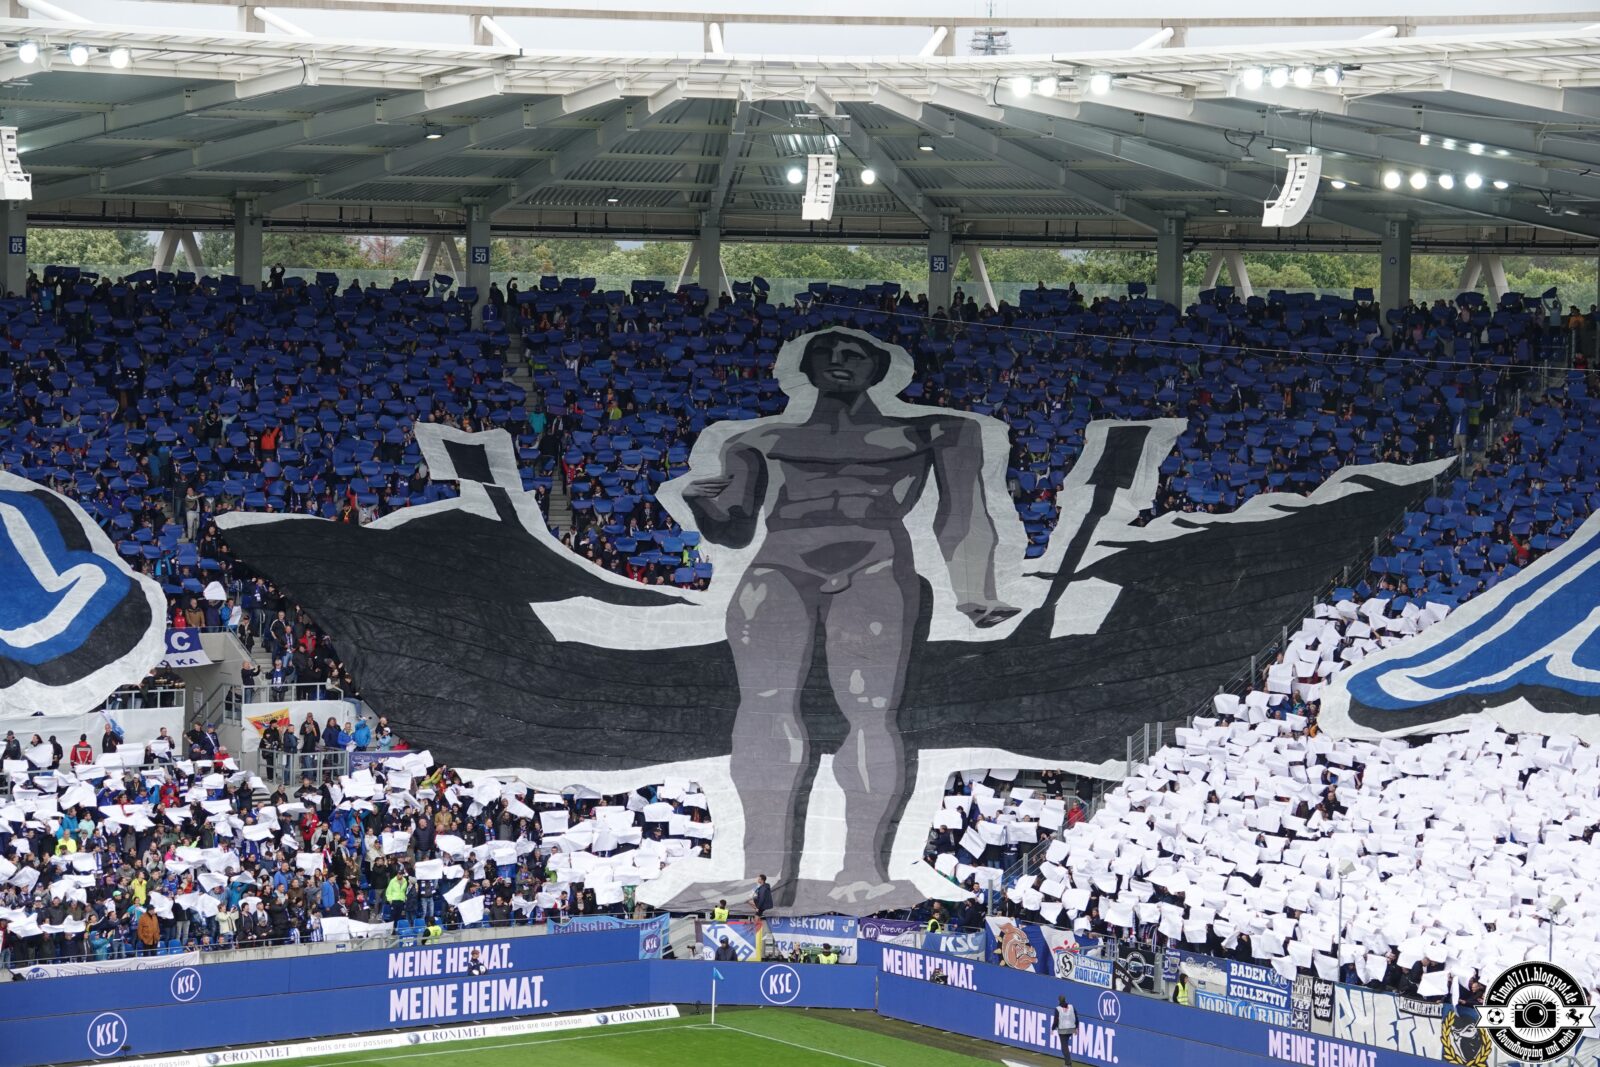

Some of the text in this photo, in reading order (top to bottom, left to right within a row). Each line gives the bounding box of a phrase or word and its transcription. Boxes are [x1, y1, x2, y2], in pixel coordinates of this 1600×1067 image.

[789, 917, 835, 931] SEKTION
[940, 933, 980, 952] KSC
[388, 949, 443, 979] MEINE
[883, 948, 924, 979] MEINE
[1230, 962, 1267, 982] BADEN
[177, 974, 195, 995] KSC
[770, 972, 792, 995] KSC
[1075, 967, 1110, 986] HOOLIGANS
[389, 975, 548, 1022] MEINE HEIMAT.
[1229, 984, 1288, 1007] KOLLEKTIV
[611, 1007, 672, 1022] CRONIMET
[1103, 998, 1116, 1016] KSC
[96, 1020, 119, 1047] KSC
[423, 1026, 488, 1042] CRONIMET
[501, 1017, 582, 1032] metals are our passion
[994, 1002, 1119, 1064] MEINE HIMAT.
[222, 1046, 292, 1062] CRONIMET
[306, 1043, 332, 1052] metals
[363, 1038, 393, 1048] passion
[1268, 1029, 1316, 1067] MEINE
